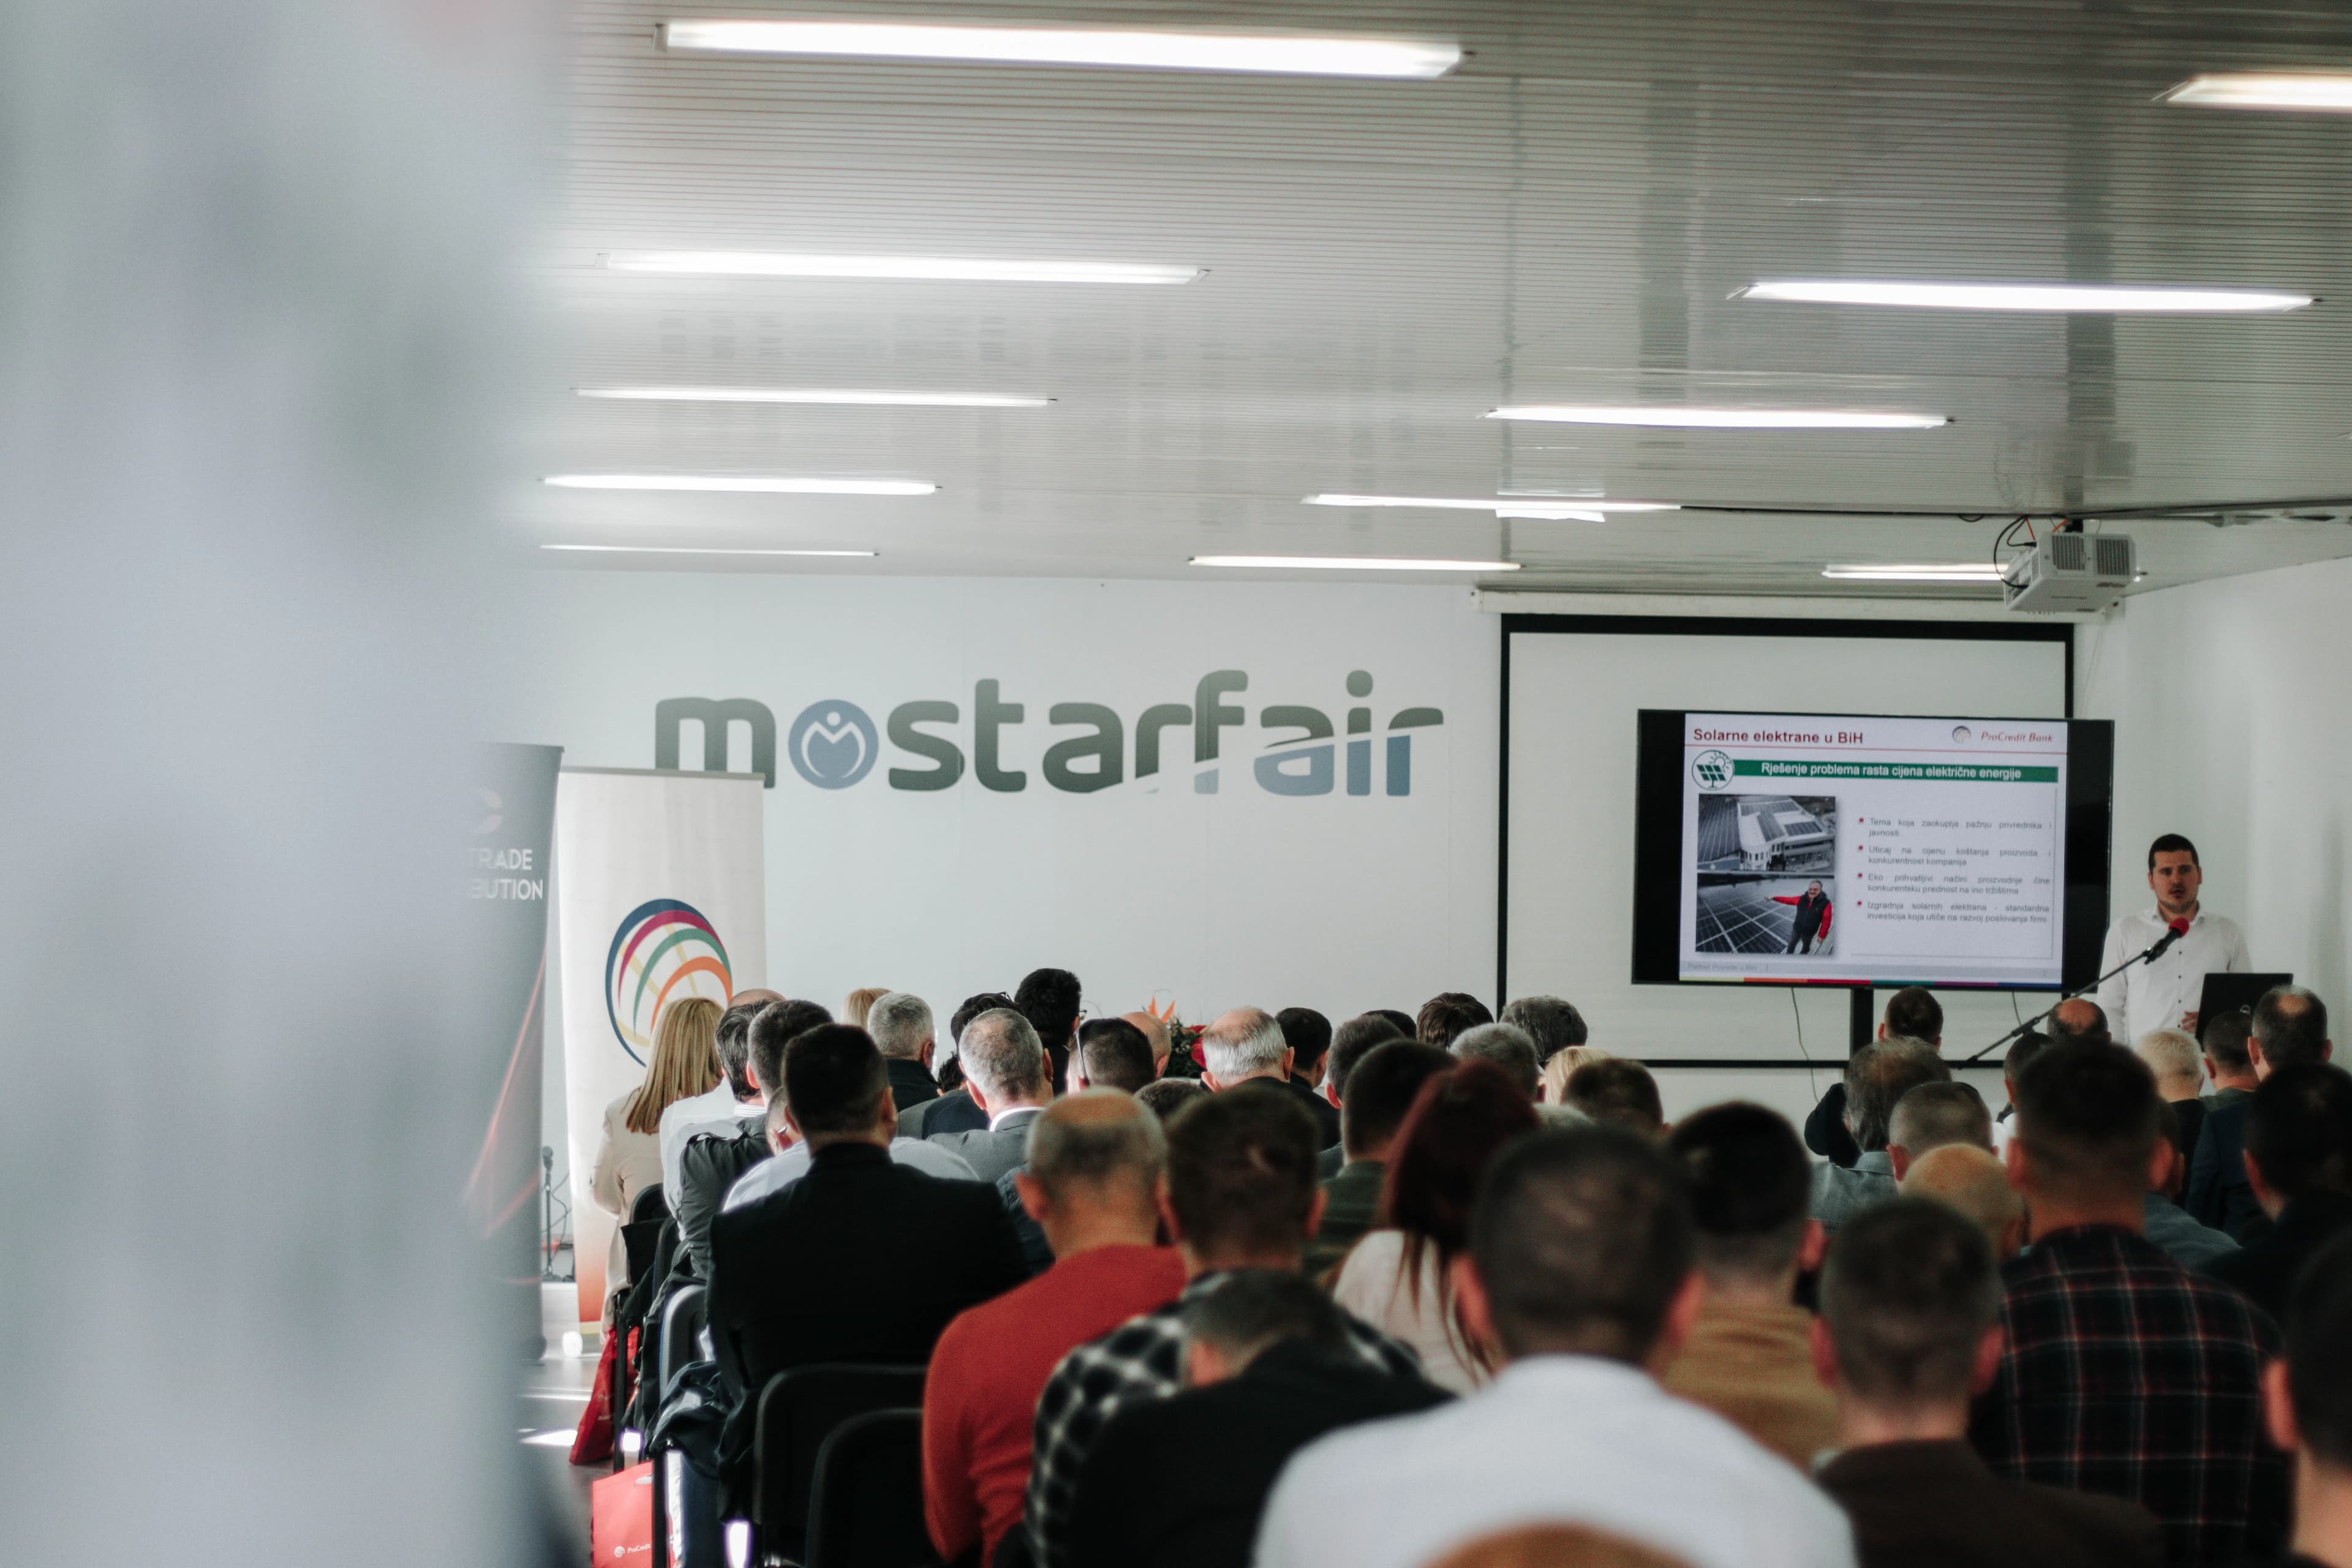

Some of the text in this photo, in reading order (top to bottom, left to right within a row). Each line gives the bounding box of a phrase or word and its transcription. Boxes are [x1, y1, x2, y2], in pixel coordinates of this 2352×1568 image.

[655, 669, 1444, 797] mostarfair
[1694, 728, 1863, 744] Solarne elektrane u BiH
[1981, 731, 2053, 743] ProCredit Bank
[1762, 762, 2021, 781] Rješenje problema rasta cijena električne energije
[1898, 818, 1915, 827] koja
[1921, 819, 1959, 829] zaokuplja
[1966, 820, 1992, 830] pažnju
[1999, 821, 2043, 830] privrednika
[1869, 829, 1899, 838] javnosti
[1869, 845, 1891, 855] Uticaj
[1922, 846, 1945, 856] cijenu
[1956, 848, 1989, 858] koštanja
[1999, 848, 2038, 858] proizvoda
[467, 848, 533, 870] TRADE
[1926, 858, 1967, 867] kompanija
[1978, 876, 2023, 885] proizvodnje
[1868, 901, 1904, 910] Izgradnja
[1868, 913, 1905, 921] investicija
[1908, 913, 1924, 921] koja
[1985, 915, 2028, 924] poslovanja
